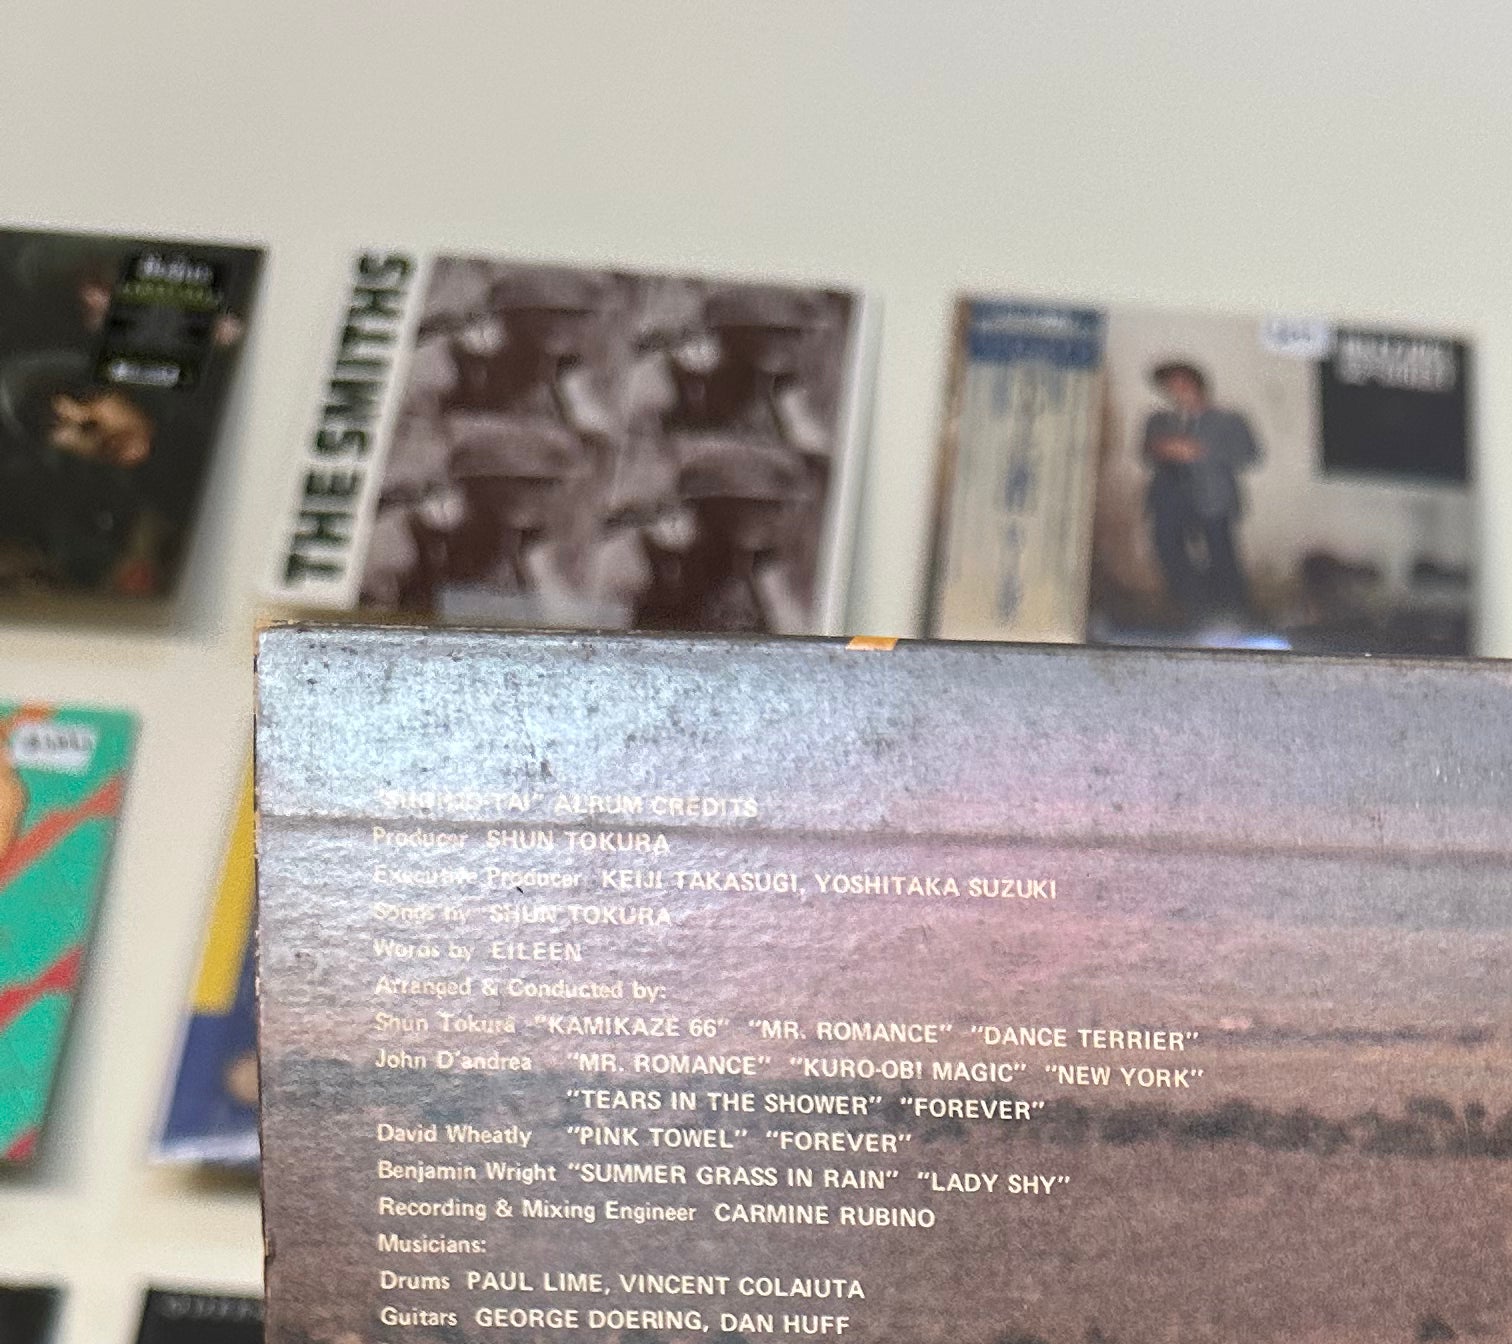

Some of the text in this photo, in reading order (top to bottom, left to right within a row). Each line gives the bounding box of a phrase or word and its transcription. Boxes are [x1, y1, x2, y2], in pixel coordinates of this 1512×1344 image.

[284, 250, 412, 586] THE SMITHS
[372, 827, 669, 855] Producer SHUN TOKURA
[601, 870, 1057, 900] KEIJI TAKASUGI, YOSHITAKA SUZUKI
[378, 1196, 936, 1229] Recording & Mixing Engineer CARMINE RUBINO
[377, 1233, 487, 1254] Musicians:
[379, 1270, 451, 1291] Drums
[467, 1271, 534, 1291] PAUL
[543, 1272, 611, 1296] LIME,
[618, 1274, 731, 1296] VINCENT
[379, 1307, 850, 1334] Guitars GEORGE DOERING, DAN HUFF
